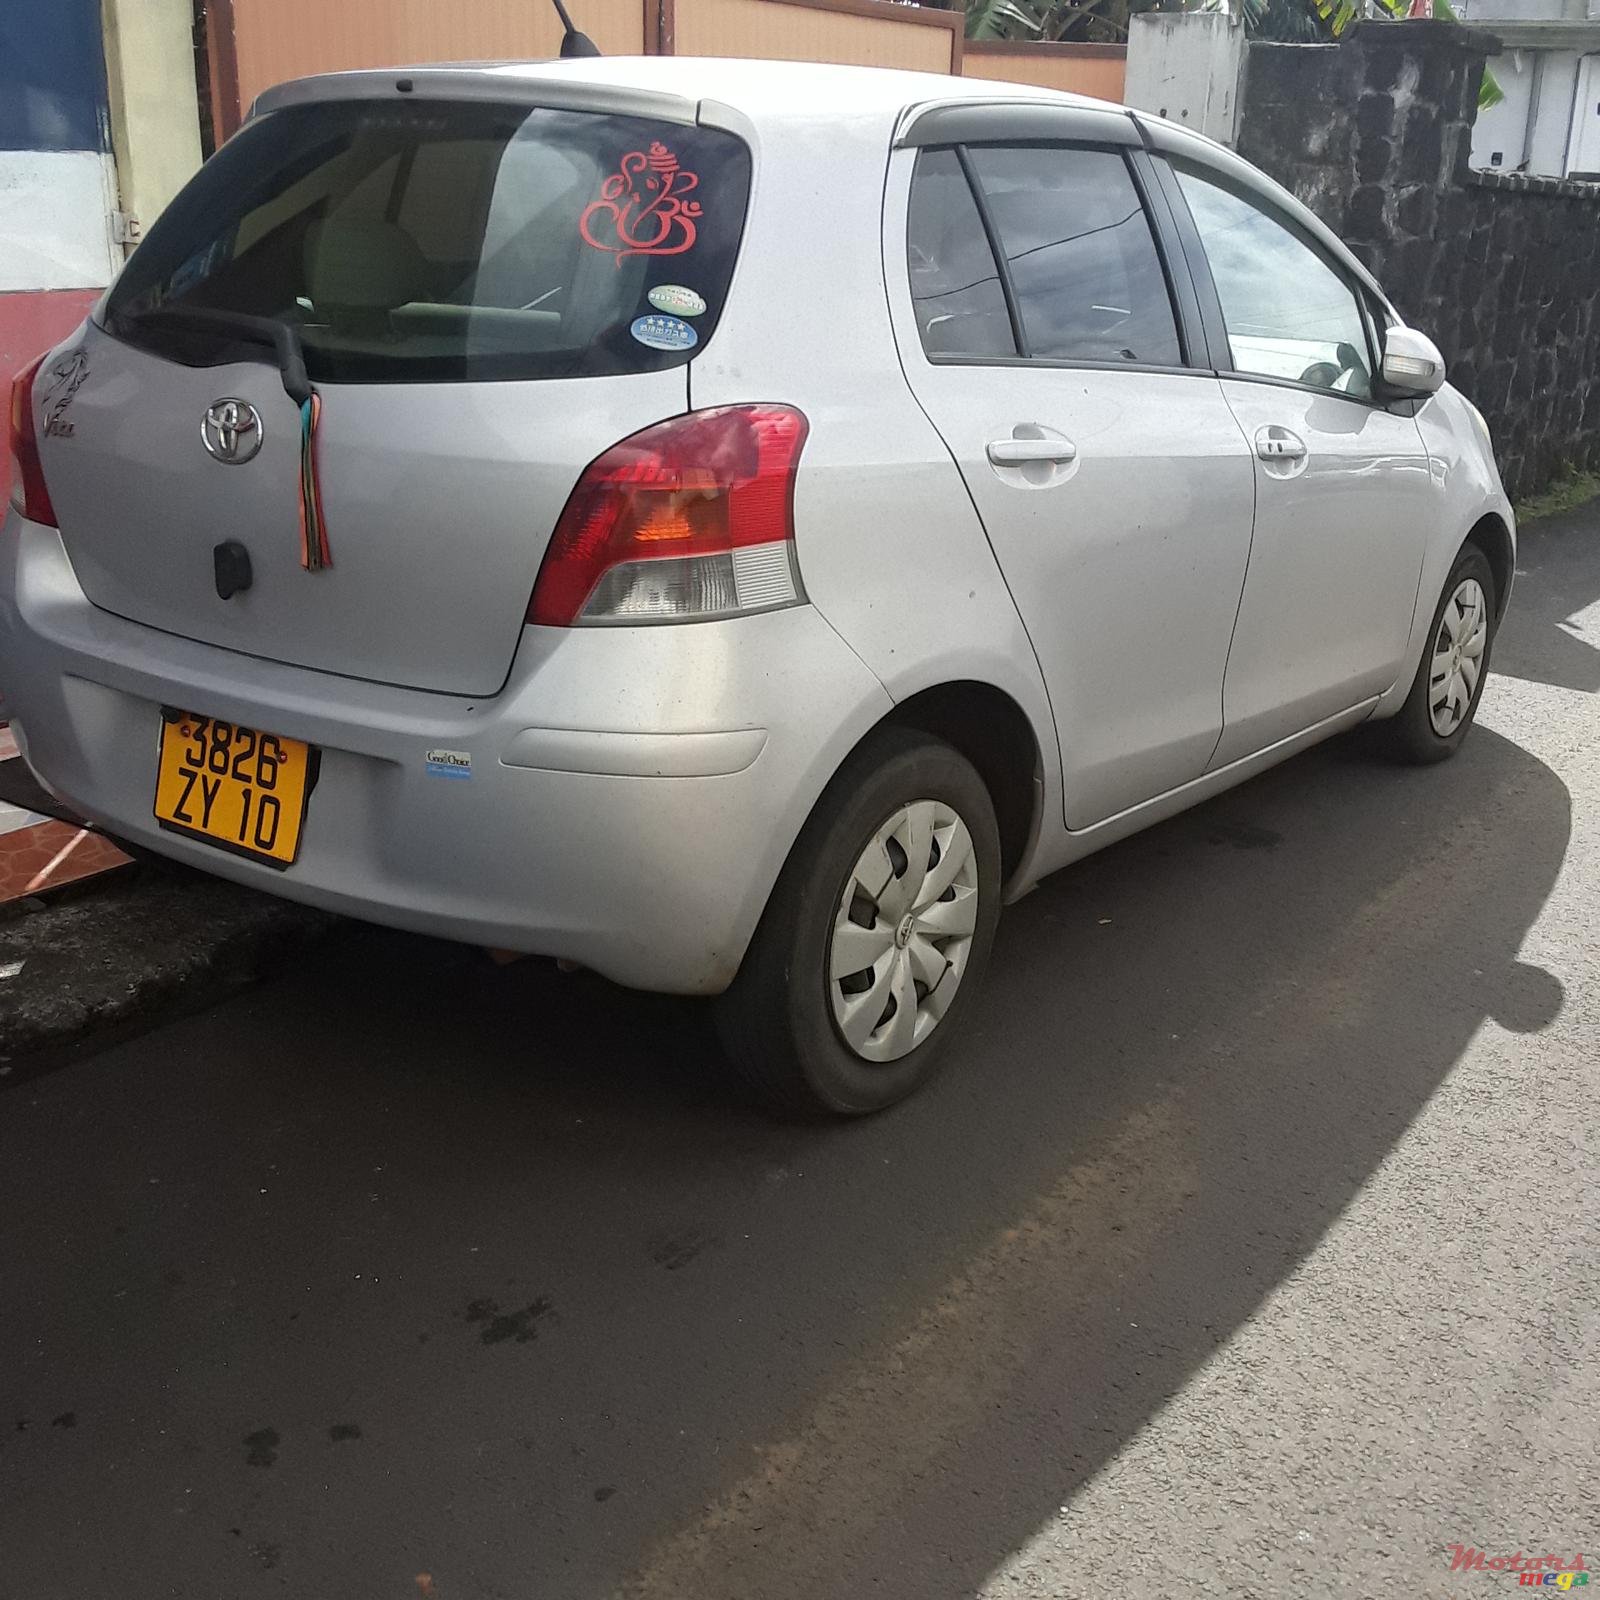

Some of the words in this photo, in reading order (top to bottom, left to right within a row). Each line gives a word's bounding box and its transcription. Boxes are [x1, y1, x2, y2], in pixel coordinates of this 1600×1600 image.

[186, 714, 281, 791] 3826
[173, 766, 222, 829] ZY
[238, 788, 281, 851] 10
